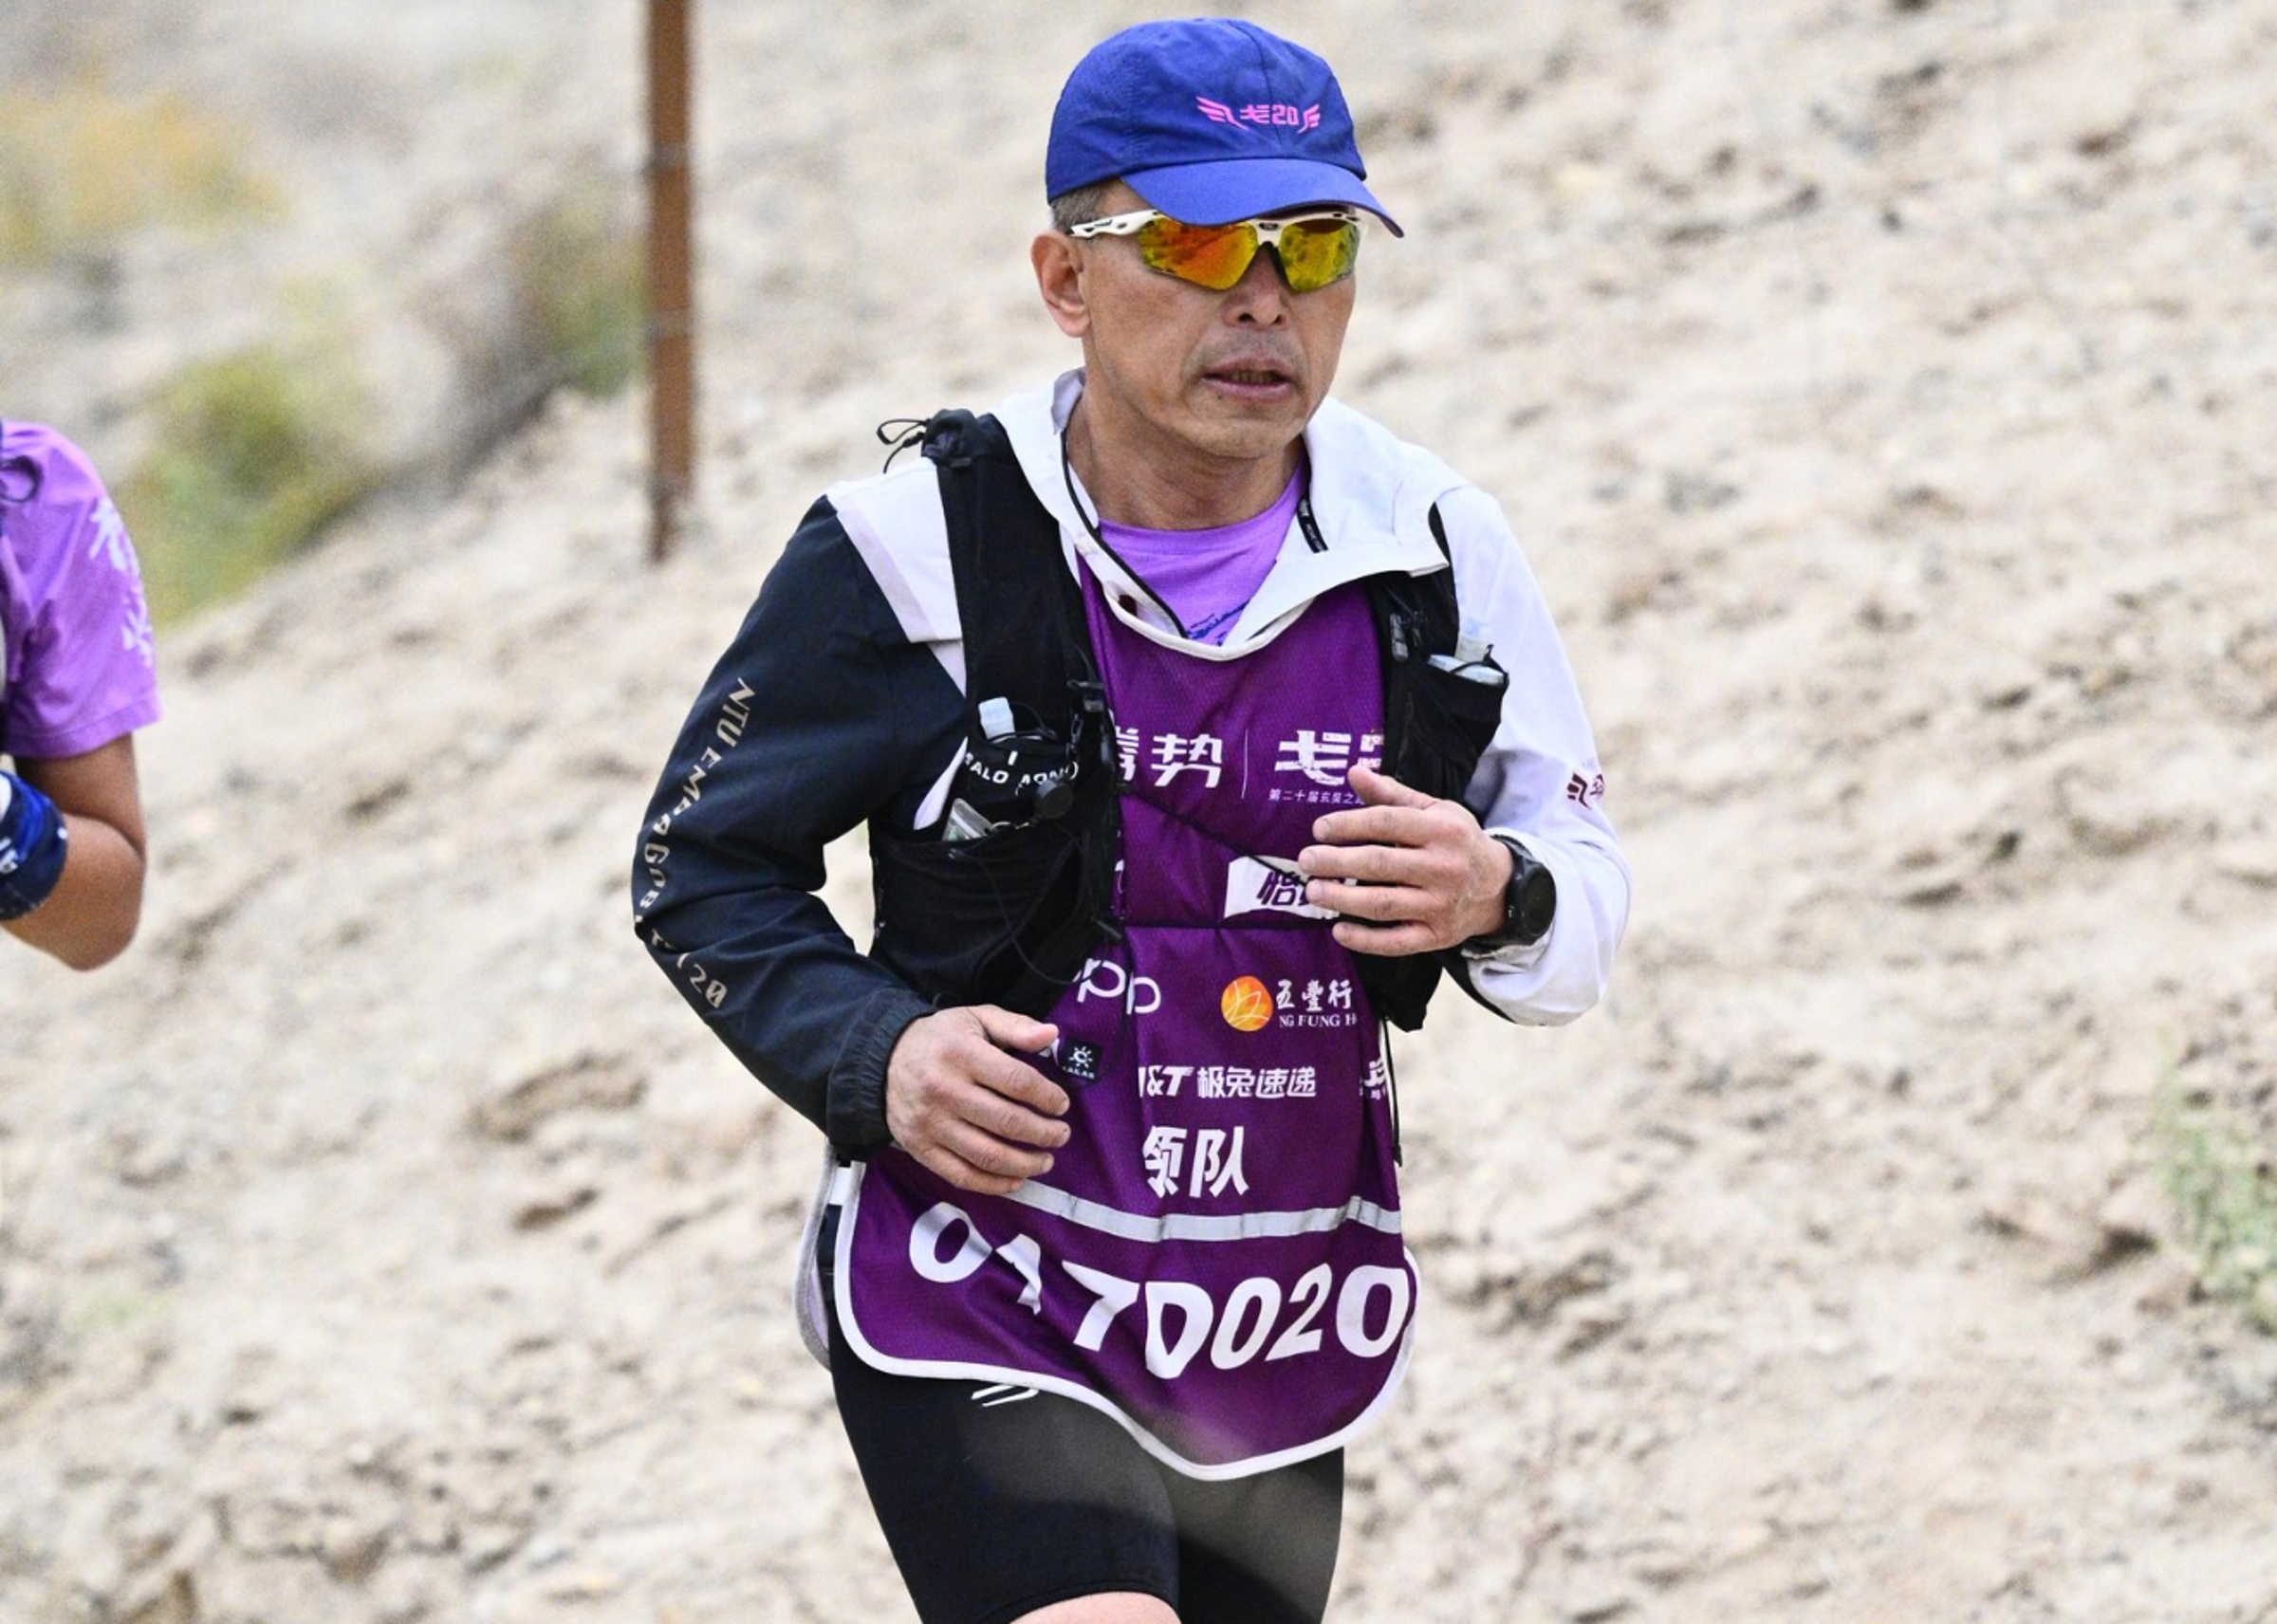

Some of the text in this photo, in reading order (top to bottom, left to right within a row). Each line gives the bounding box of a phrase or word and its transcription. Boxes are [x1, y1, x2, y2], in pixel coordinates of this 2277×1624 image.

[716, 676, 755, 747] NTU
[1268, 788, 1367, 805] 第二十届玄奘之
[1256, 870, 1311, 907] 怡
[1279, 1014, 1295, 1028] NG
[1298, 1014, 1341, 1027] FUNG
[1196, 1065, 1317, 1099] 极兔速递
